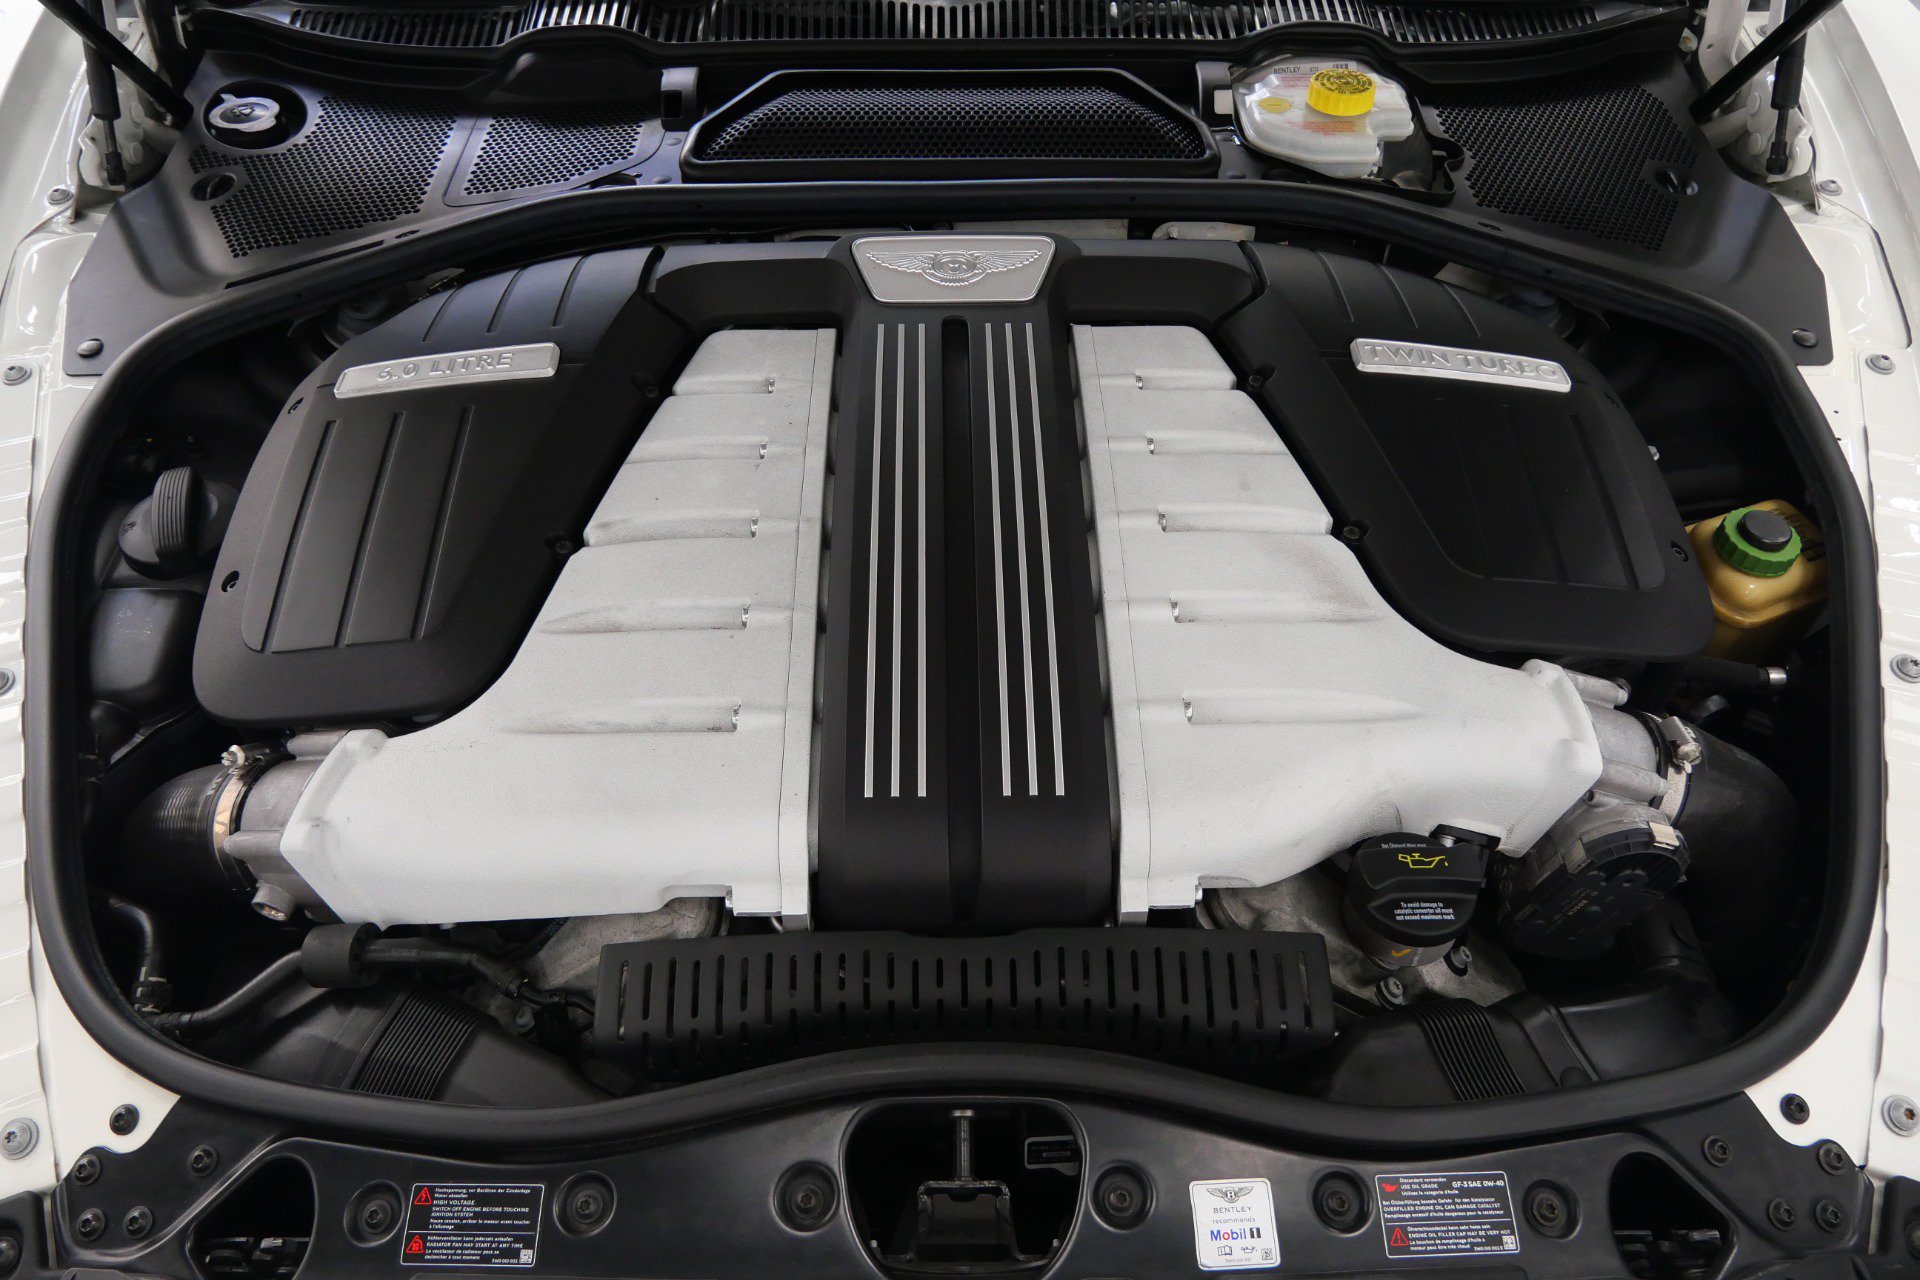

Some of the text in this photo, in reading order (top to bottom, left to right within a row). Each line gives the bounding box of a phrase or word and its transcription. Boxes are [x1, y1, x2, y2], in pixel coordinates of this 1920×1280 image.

[377, 352, 513, 382] 6.0 LITRE
[1364, 345, 1558, 378] TWIN TURBO
[1210, 1228, 1246, 1241] Mobil
